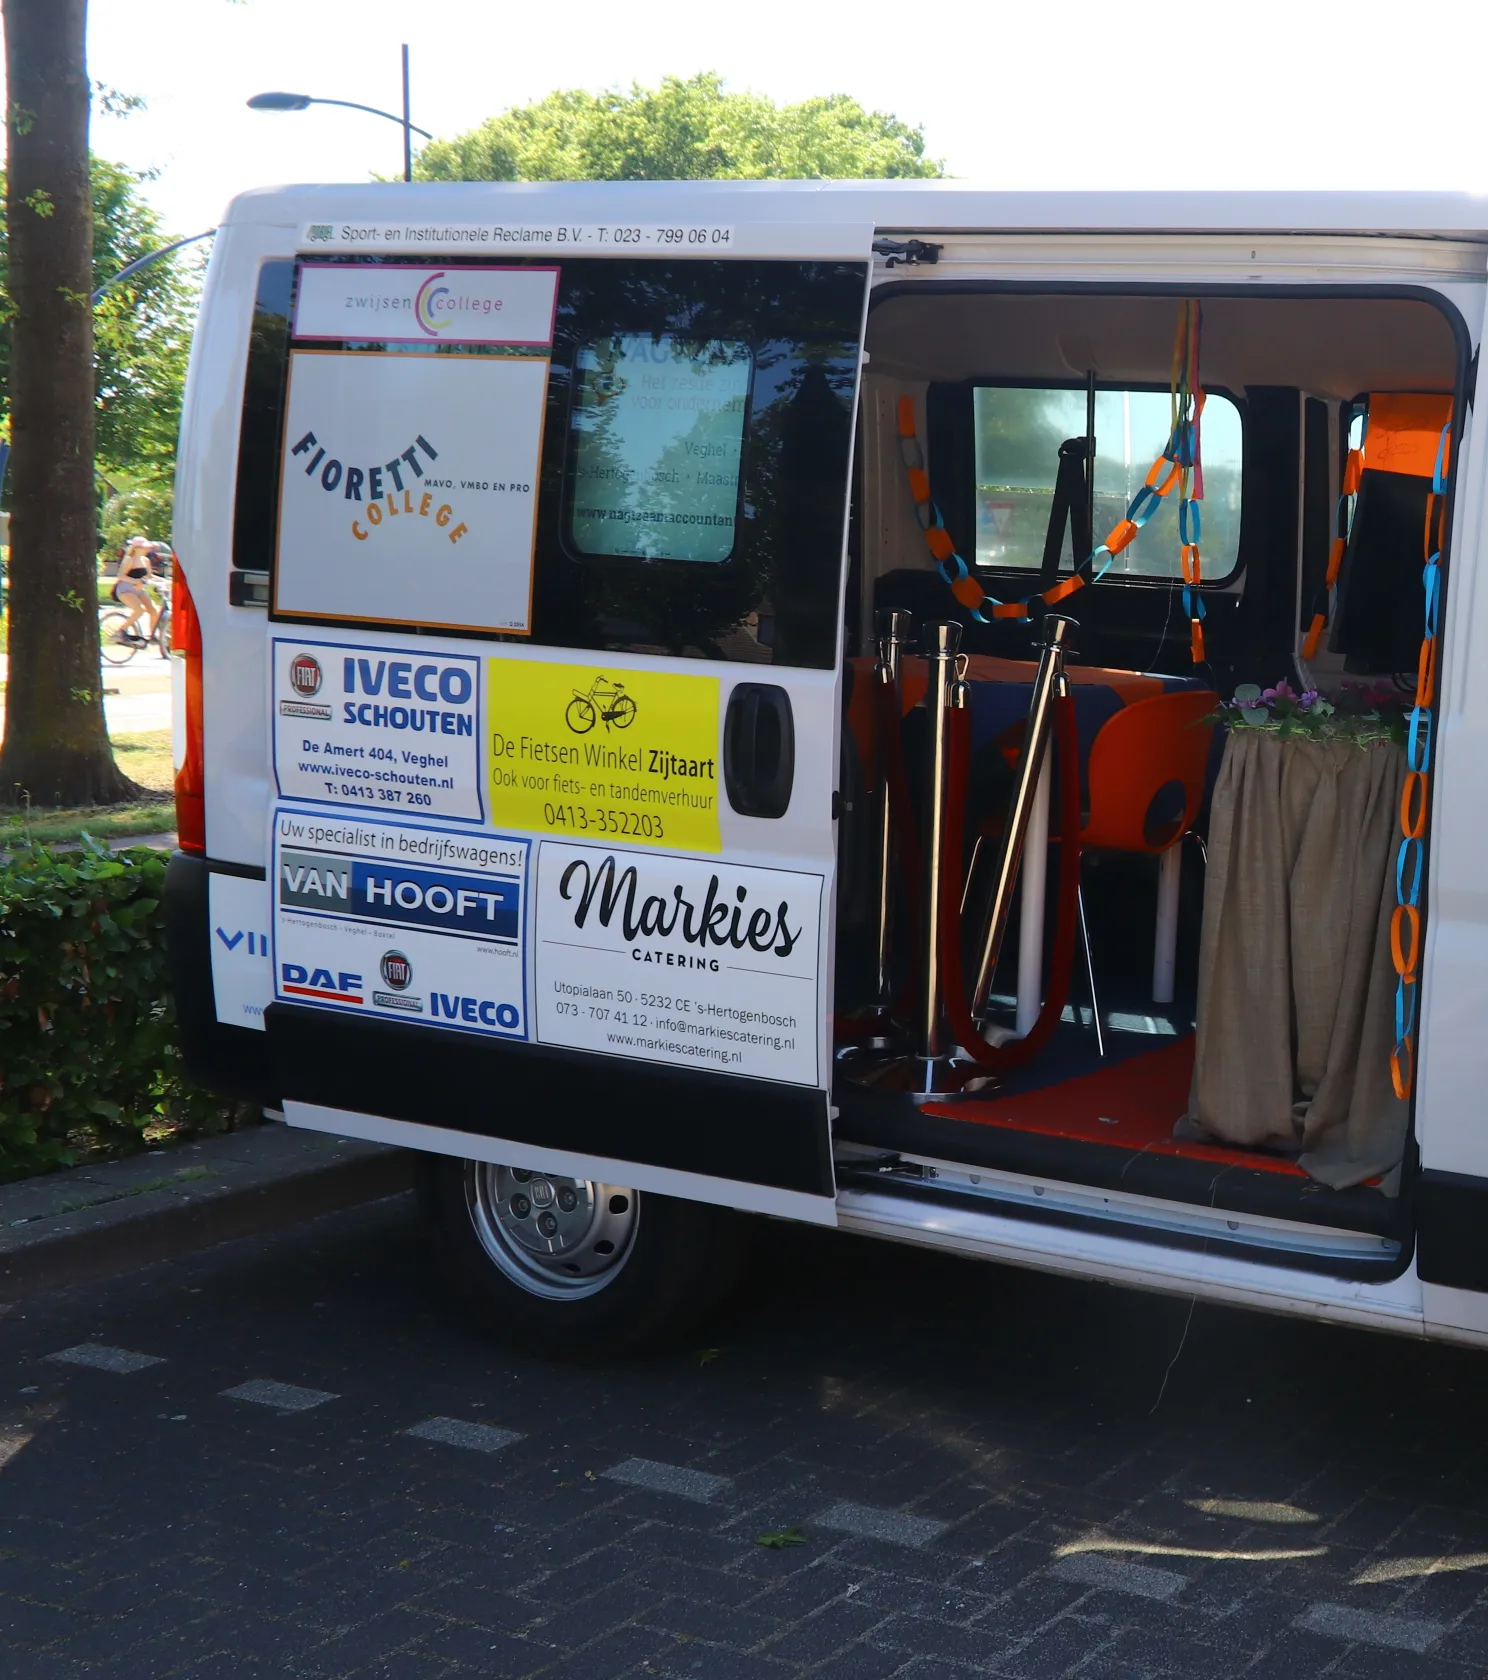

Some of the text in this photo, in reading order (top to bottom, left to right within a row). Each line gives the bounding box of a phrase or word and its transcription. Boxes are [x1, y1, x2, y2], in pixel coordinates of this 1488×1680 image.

[341, 226, 380, 242] Sport-
[385, 229, 400, 241] en
[405, 227, 489, 242] Institutionele
[493, 227, 552, 242] Reclame
[557, 228, 582, 242] B.V.
[598, 228, 608, 243] T:
[614, 228, 641, 243] 023
[656, 229, 683, 244] 799
[688, 229, 706, 244] 06
[712, 229, 730, 244] 04
[346, 296, 503, 314] zwijsen college
[685, 442, 727, 458] Veghel
[291, 431, 438, 501] FIORETTI
[424, 478, 530, 493] MAVO, VMBO EN PRO
[352, 489, 468, 544] COLLEGE
[296, 666, 316, 688] FIAT
[344, 657, 472, 705] IVECO
[283, 704, 330, 718] PROFESSIONAL
[344, 701, 472, 737] SCHOUTEN
[302, 739, 448, 769] De Amert 404, Veghel
[493, 733, 714, 780] De Fietsen Winkel Zijtaart
[298, 762, 454, 790] www.iveco-schouten.nl
[493, 767, 714, 810] Ook voor fiets- en tandemverhuur
[325, 782, 432, 807] T: 0413 387 260
[544, 802, 664, 839] 0413-352203
[280, 818, 523, 868] Uw specialist in bedrijfswagens!
[283, 864, 504, 921] VAN HOOFT
[559, 855, 803, 958] Markies
[344, 924, 368, 936] Veghel
[373, 930, 396, 940] Boxtel
[476, 945, 519, 959] www.hooft.nl
[632, 948, 720, 972] CATERING
[282, 963, 363, 991] DAF
[388, 961, 406, 982] FIAT
[430, 992, 520, 1029] IVECO
[554, 980, 613, 1001] Utopialaan
[617, 989, 632, 1004] 50
[640, 993, 672, 1010] 5232
[675, 998, 691, 1012] CE
[694, 1001, 797, 1029] 's-Hertogenbosch
[556, 1001, 579, 1017] 073
[588, 1006, 610, 1021] 707
[613, 1011, 629, 1025] 41
[632, 1013, 648, 1027] 12
[655, 1016, 795, 1050] info@markiescatering.nl
[606, 1031, 742, 1063] www.markiescatering.nl
